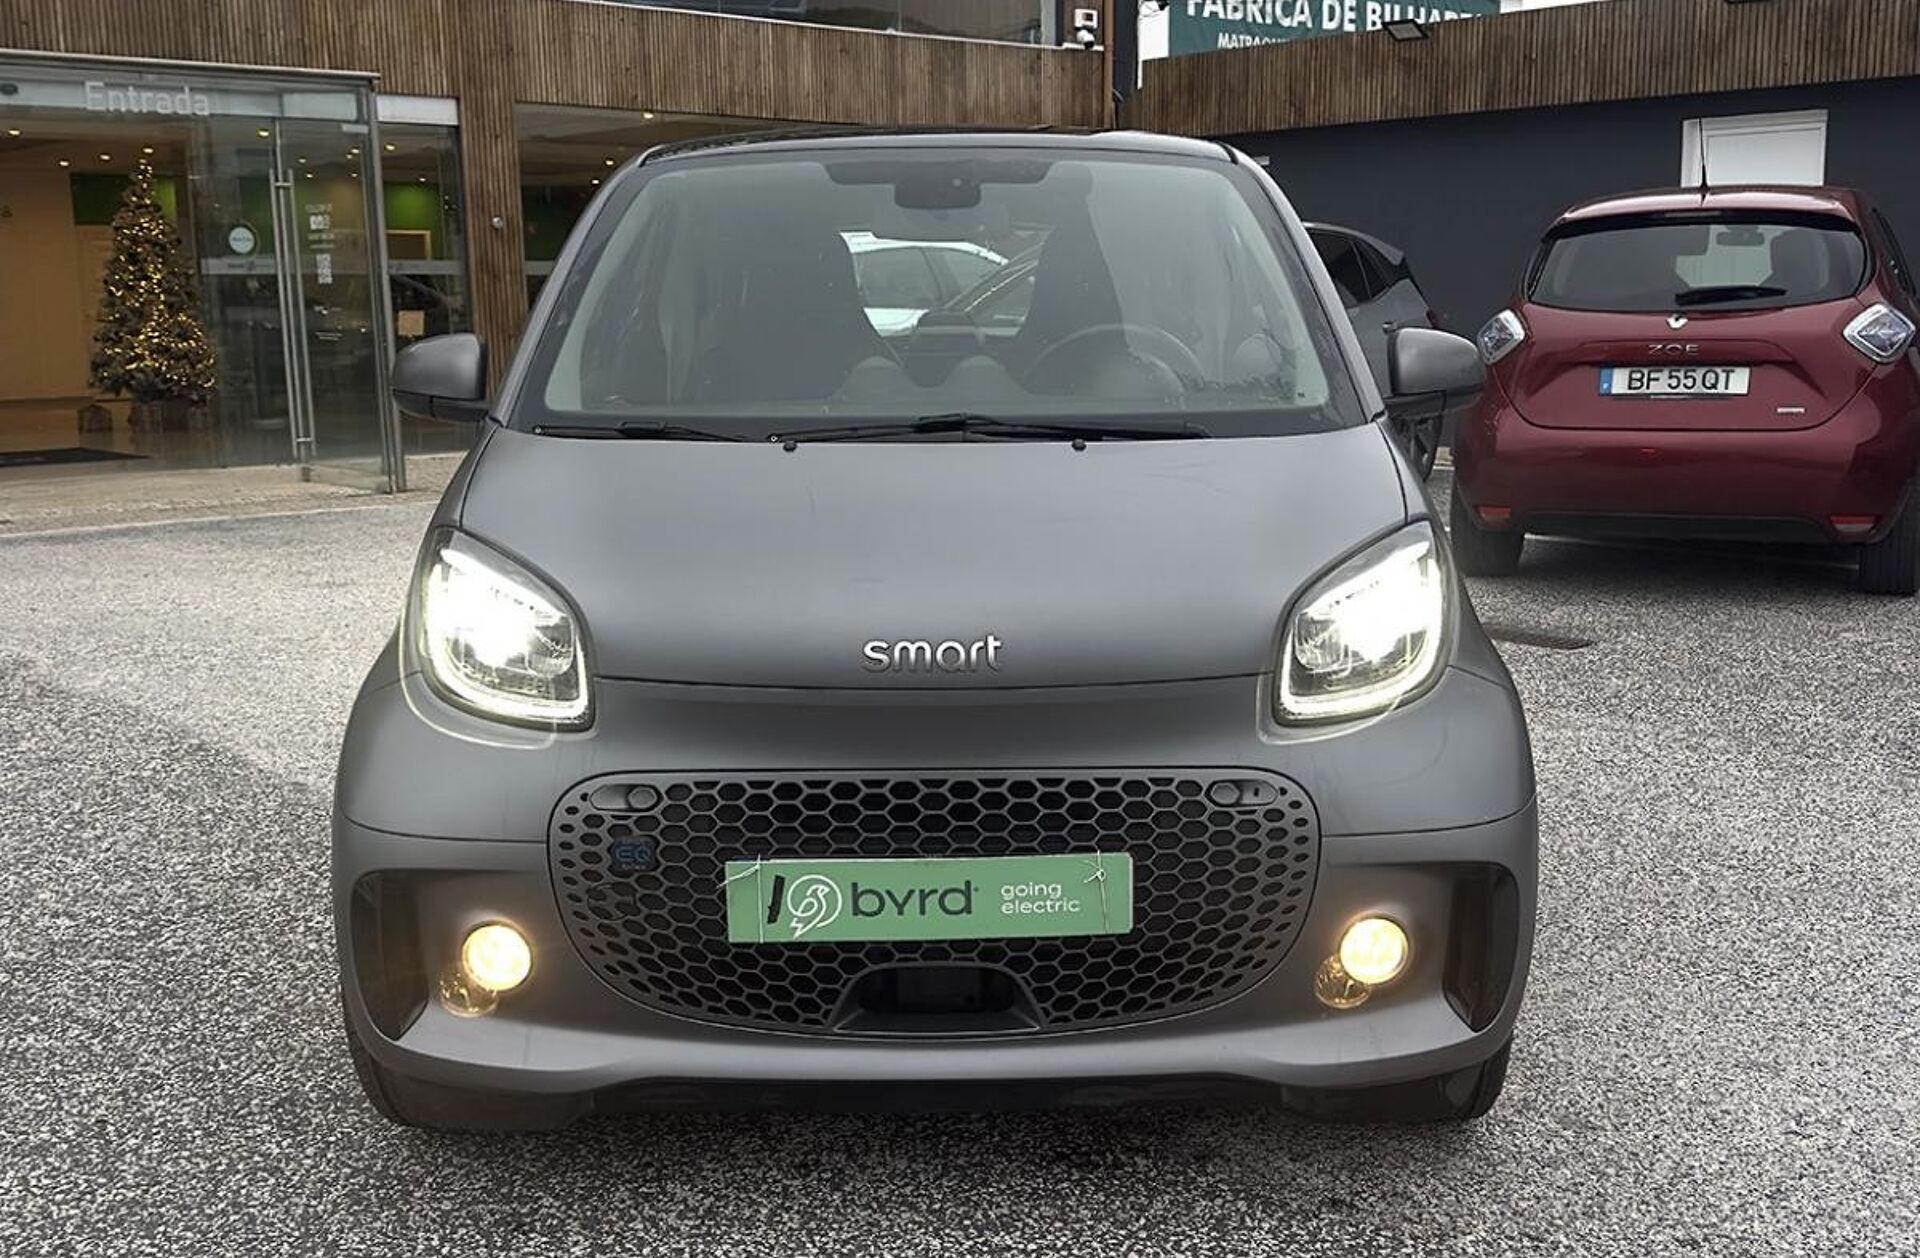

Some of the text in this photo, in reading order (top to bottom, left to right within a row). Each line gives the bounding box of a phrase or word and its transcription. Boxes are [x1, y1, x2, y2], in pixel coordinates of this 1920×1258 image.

[1322, 0, 1356, 32] DE
[85, 81, 210, 115] Entrada
[1649, 344, 1700, 355] ZOE
[1627, 368, 1736, 391] BF 55 QT
[863, 635, 1002, 672] smart
[615, 844, 652, 865] EQ
[851, 880, 973, 917] byrd
[1001, 882, 1062, 900] going
[1001, 898, 1081, 914] electric
